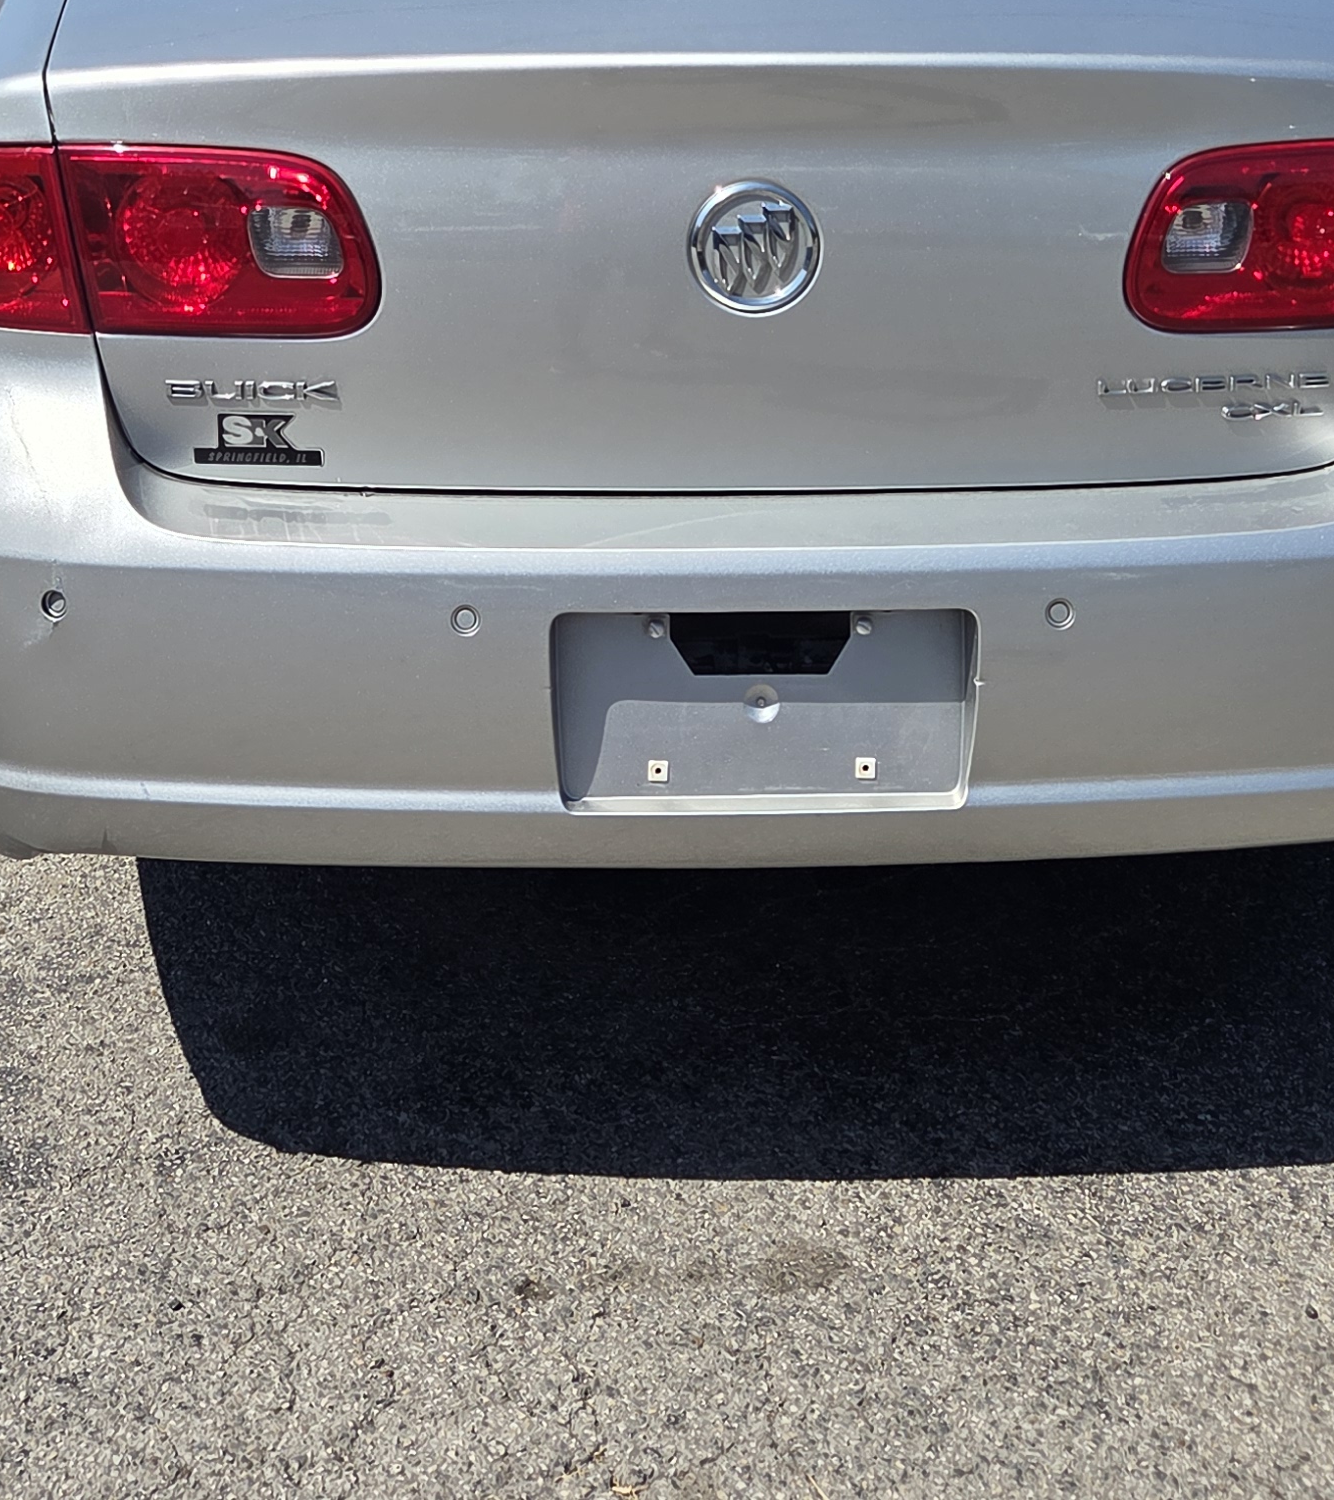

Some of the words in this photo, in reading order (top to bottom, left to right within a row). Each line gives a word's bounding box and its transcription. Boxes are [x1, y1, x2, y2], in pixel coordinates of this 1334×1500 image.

[165, 380, 341, 401] BUICK
[1097, 371, 1330, 396] LUCERNE
[1221, 401, 1324, 420] CXL
[208, 451, 290, 463] SPRINGFIELD,
[296, 452, 307, 463] IL
